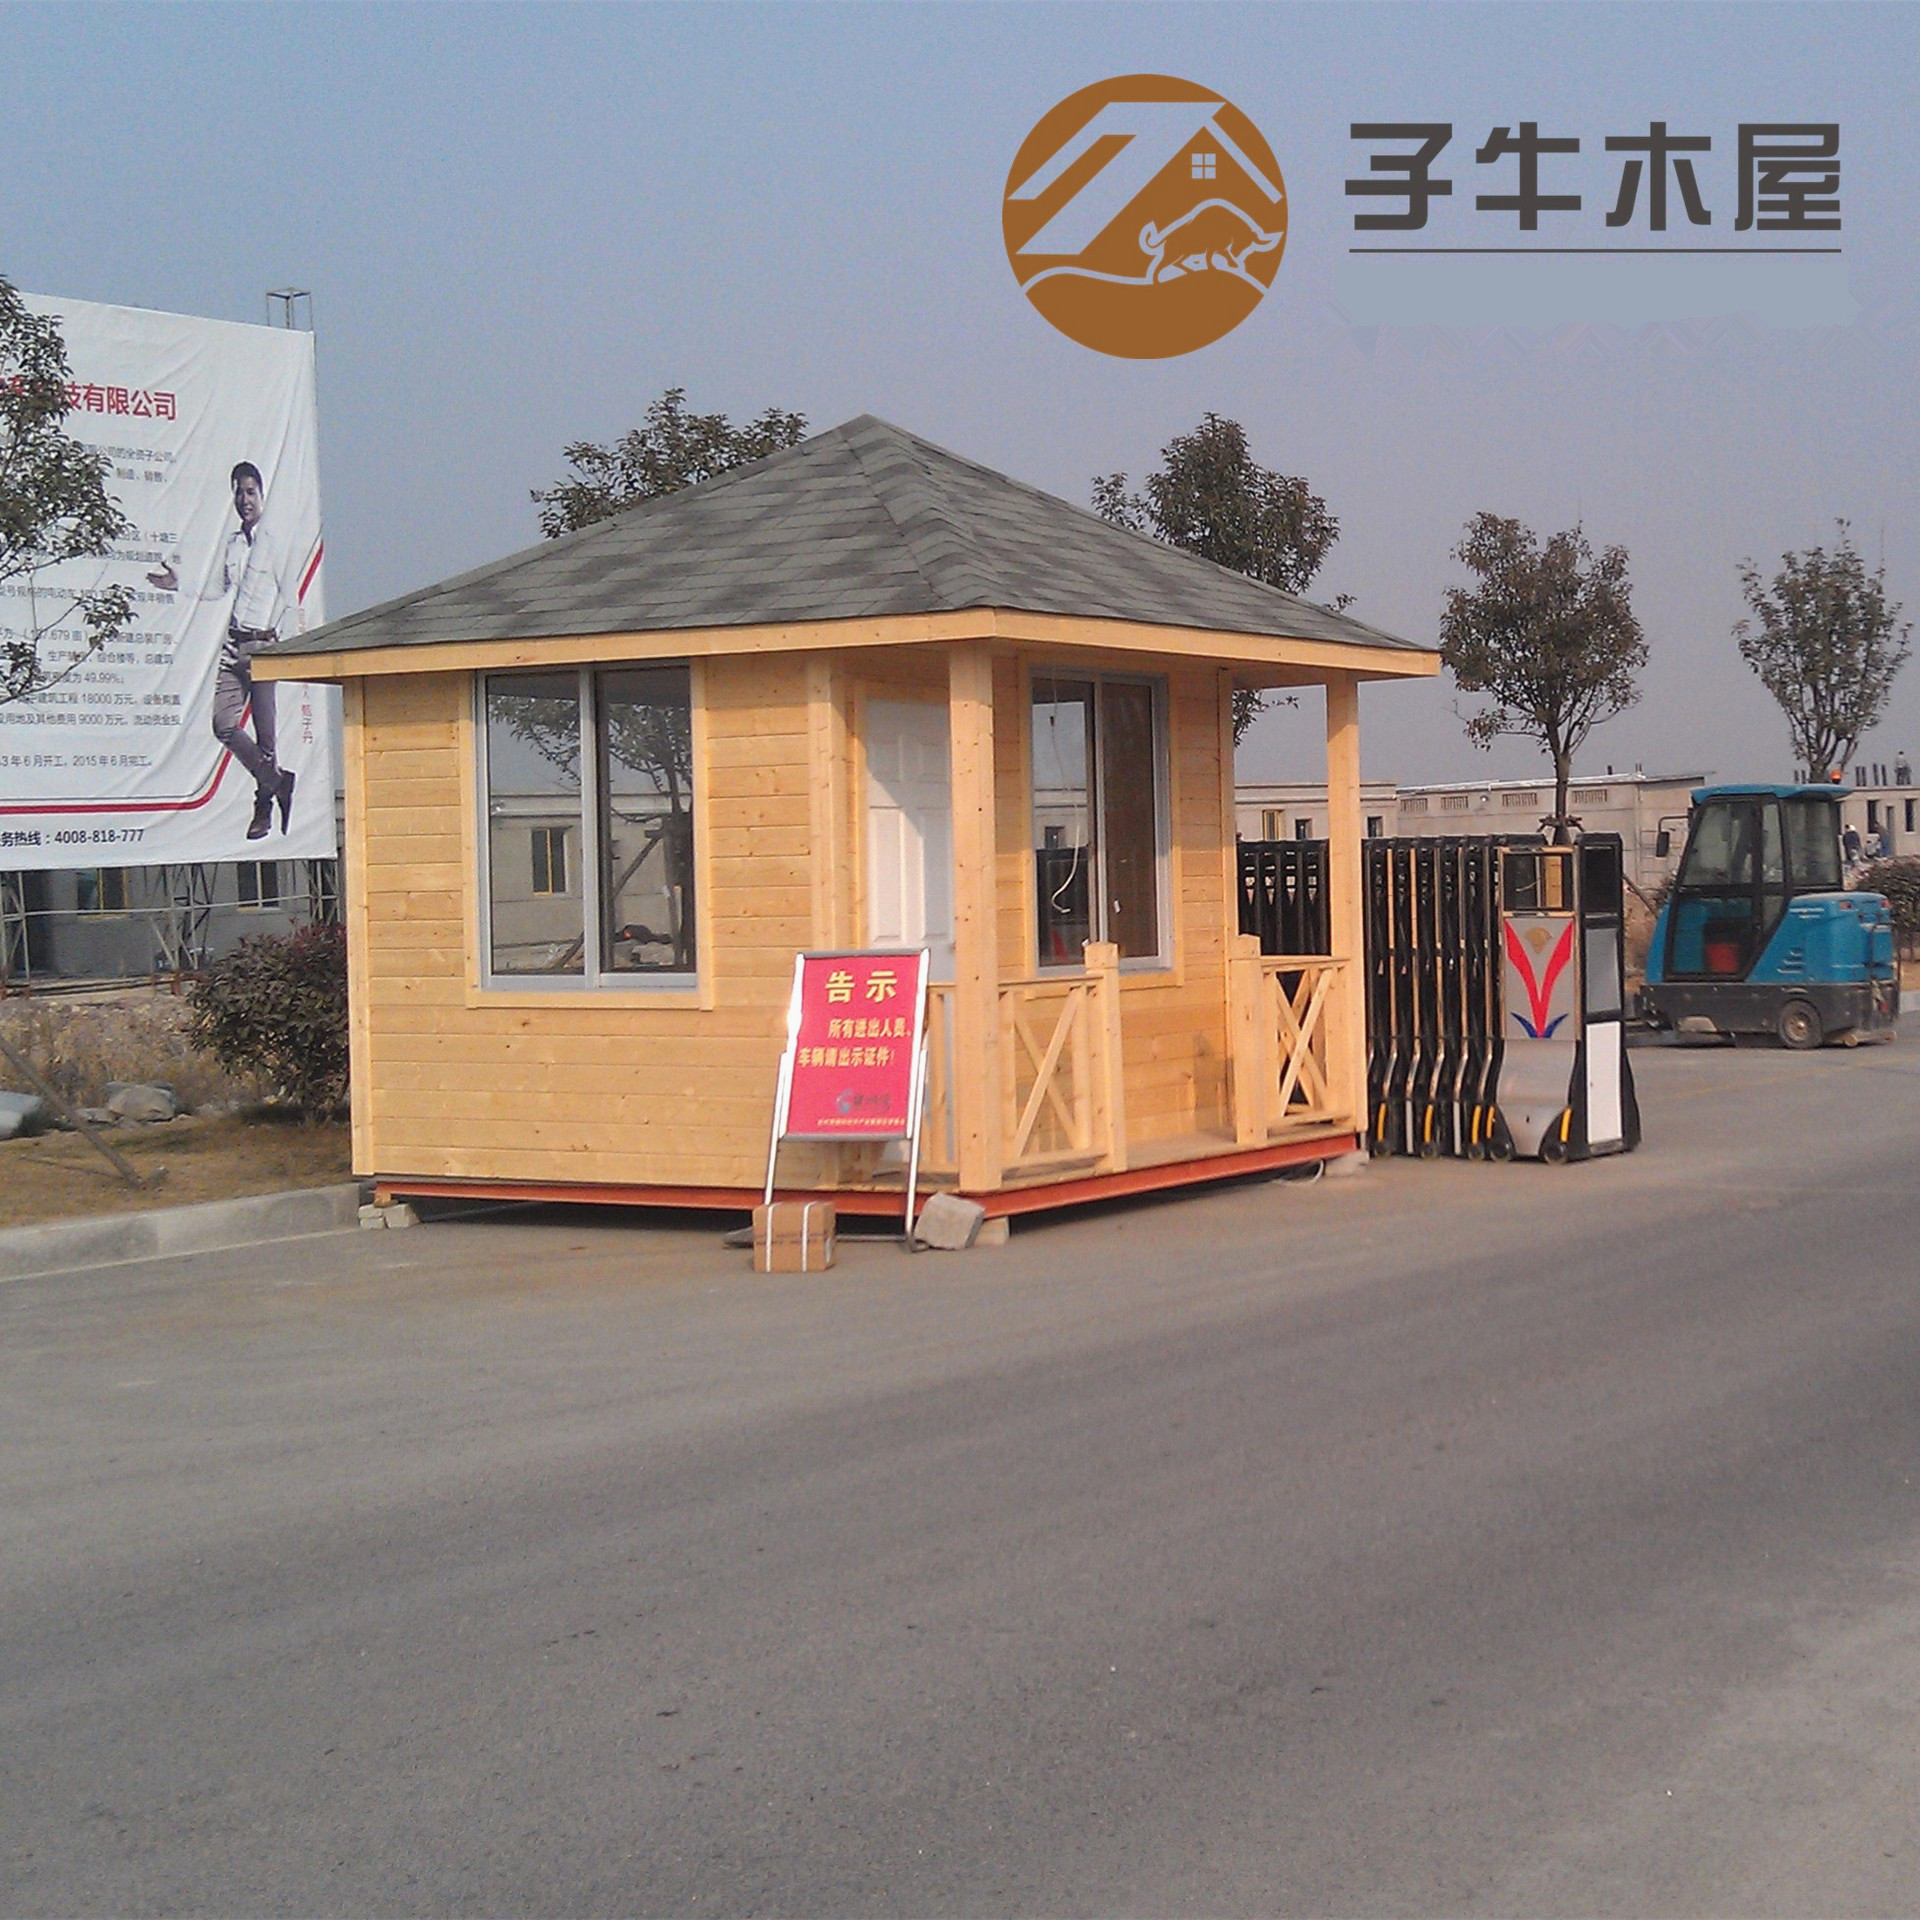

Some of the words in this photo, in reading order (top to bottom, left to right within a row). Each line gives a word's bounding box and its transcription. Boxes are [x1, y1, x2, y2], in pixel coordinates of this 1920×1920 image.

[0, 829, 144, 847] 务热线：4008-818-777
[825, 970, 898, 1004] 告示
